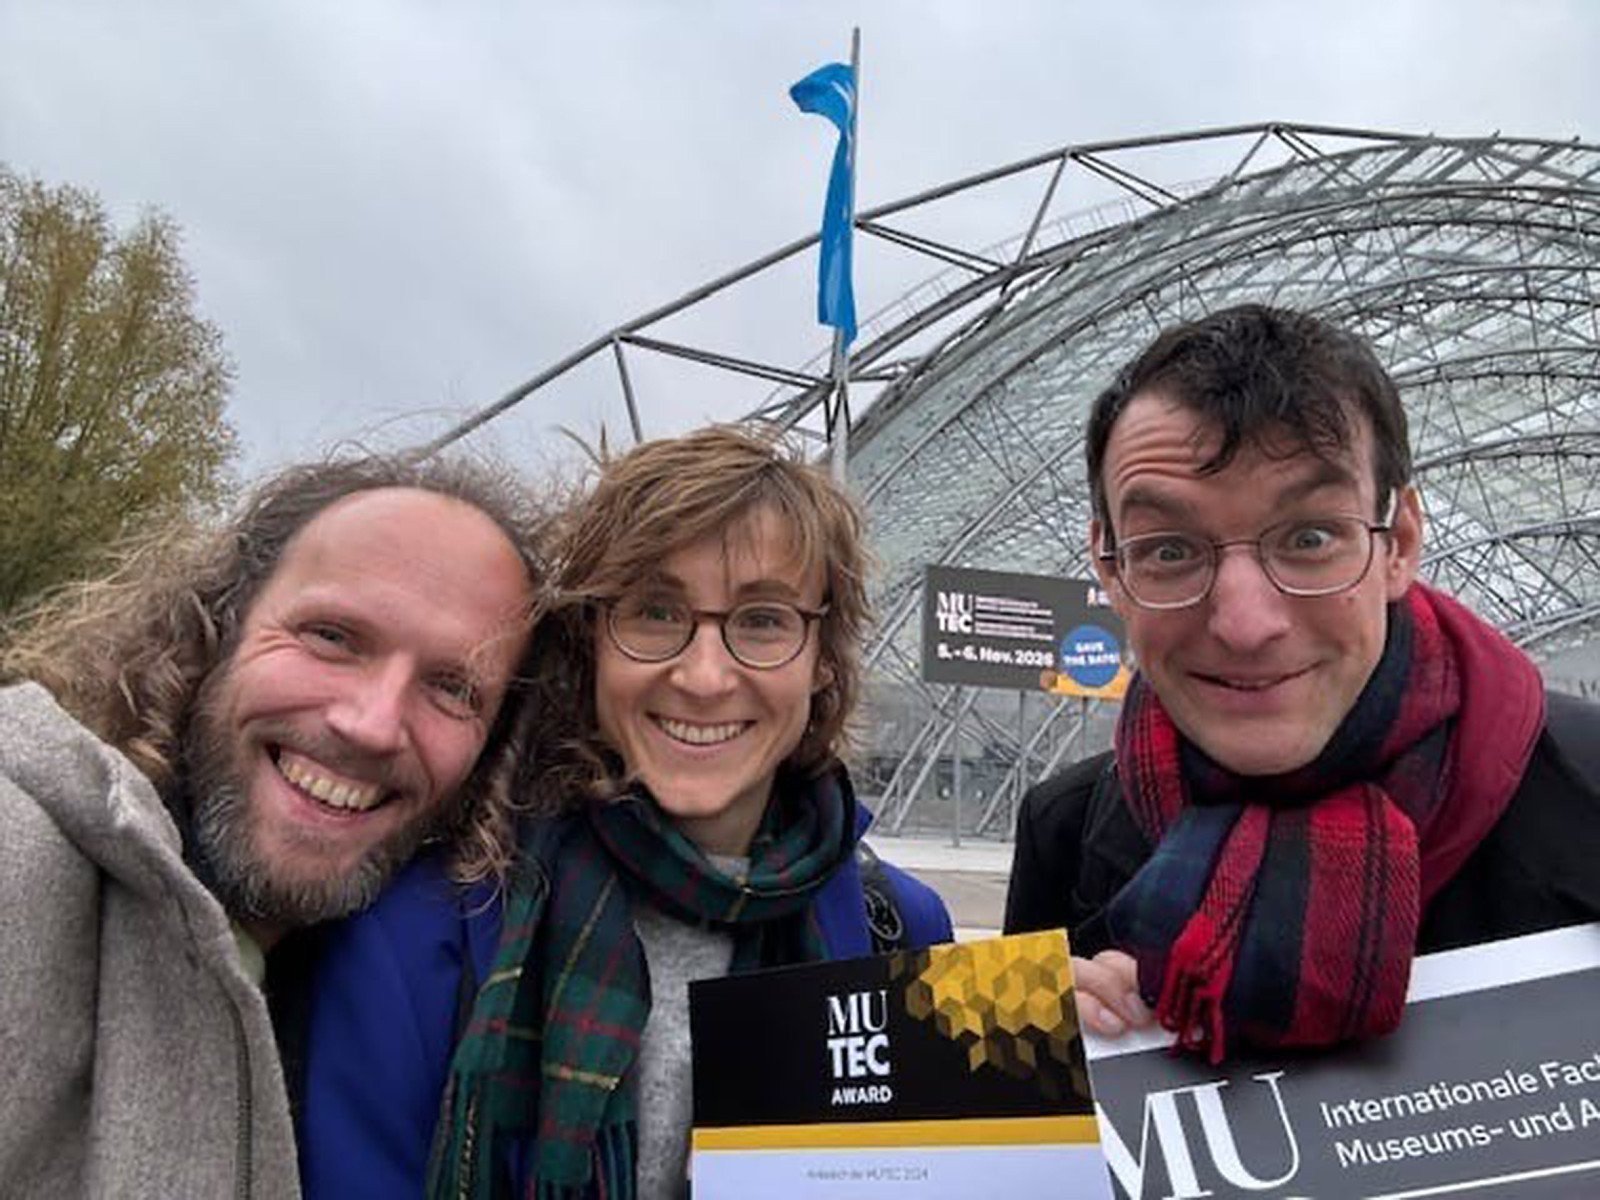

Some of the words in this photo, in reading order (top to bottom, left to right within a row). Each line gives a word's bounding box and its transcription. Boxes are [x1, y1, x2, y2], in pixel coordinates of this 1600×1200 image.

[937, 592, 973, 613] MU
[937, 611, 973, 633] TEC
[827, 990, 889, 1035] MU
[827, 1033, 891, 1078] TEC
[831, 1085, 893, 1105] AWARD
[1320, 1069, 1539, 1128] Internationale
[1540, 1053, 1600, 1089] Fac
[1095, 1071, 1299, 1200] MU
[1335, 1123, 1504, 1168] Museums-
[1508, 1102, 1575, 1139] und
